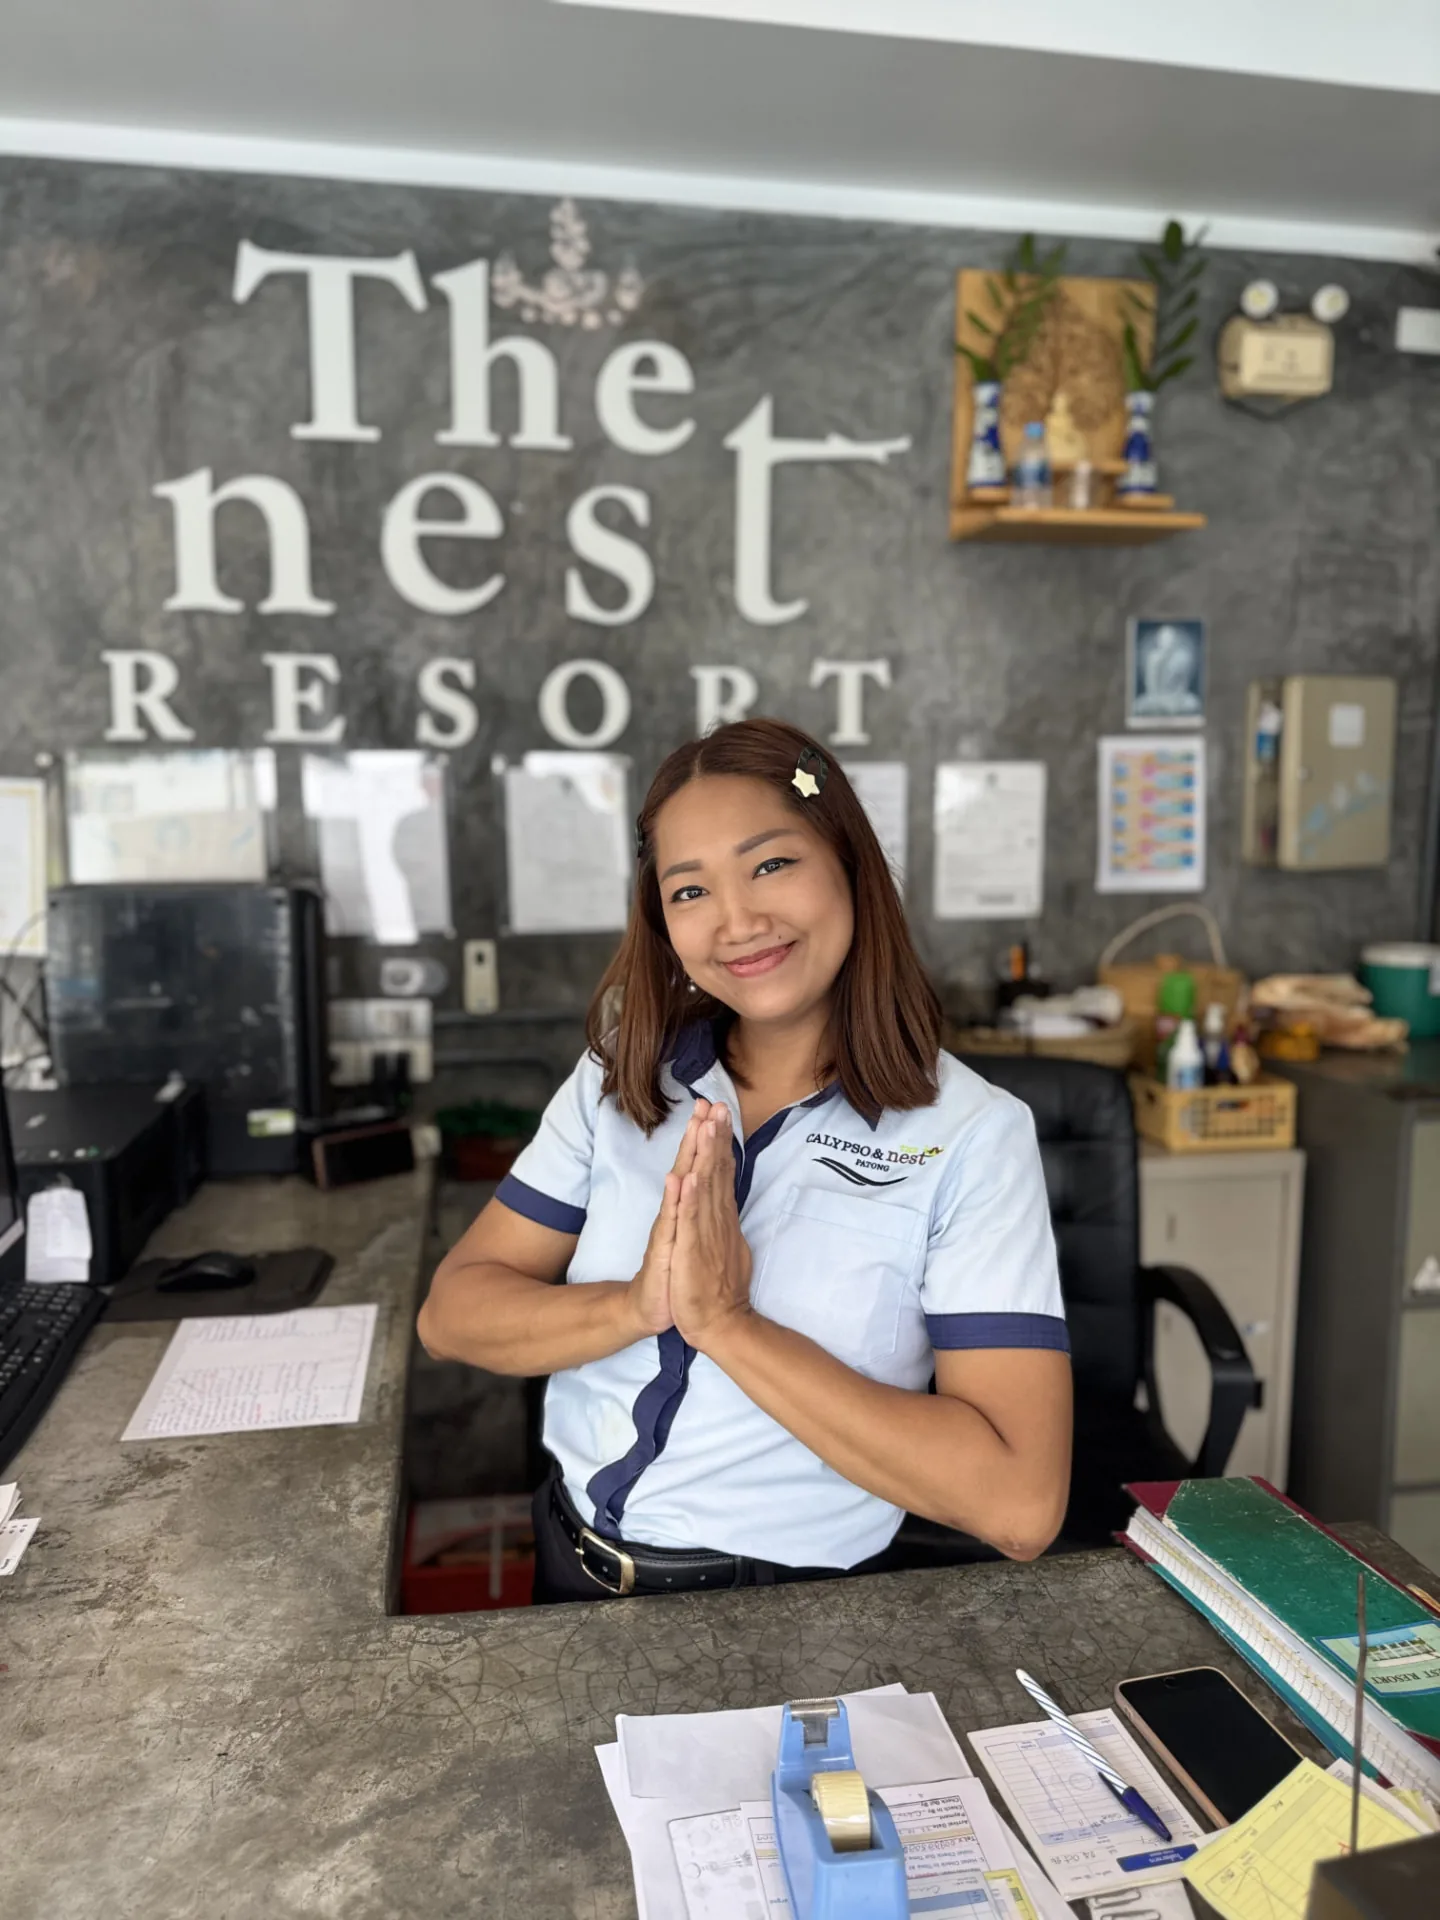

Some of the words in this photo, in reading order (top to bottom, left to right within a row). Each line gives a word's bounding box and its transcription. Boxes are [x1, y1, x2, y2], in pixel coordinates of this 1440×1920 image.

[232, 239, 697, 456] The
[152, 393, 912, 627] nest
[102, 648, 892, 749] RESORT
[806, 1132, 872, 1157] CALYPSO
[872, 1147, 884, 1161] &
[886, 1149, 932, 1166] nest
[855, 1158, 890, 1173] PATONG
[1371, 1672, 1421, 1684] RESORT
[1422, 1668, 1440, 1679] ST
[941, 1797, 960, 1805] Check
[939, 1812, 966, 1820] Payment
